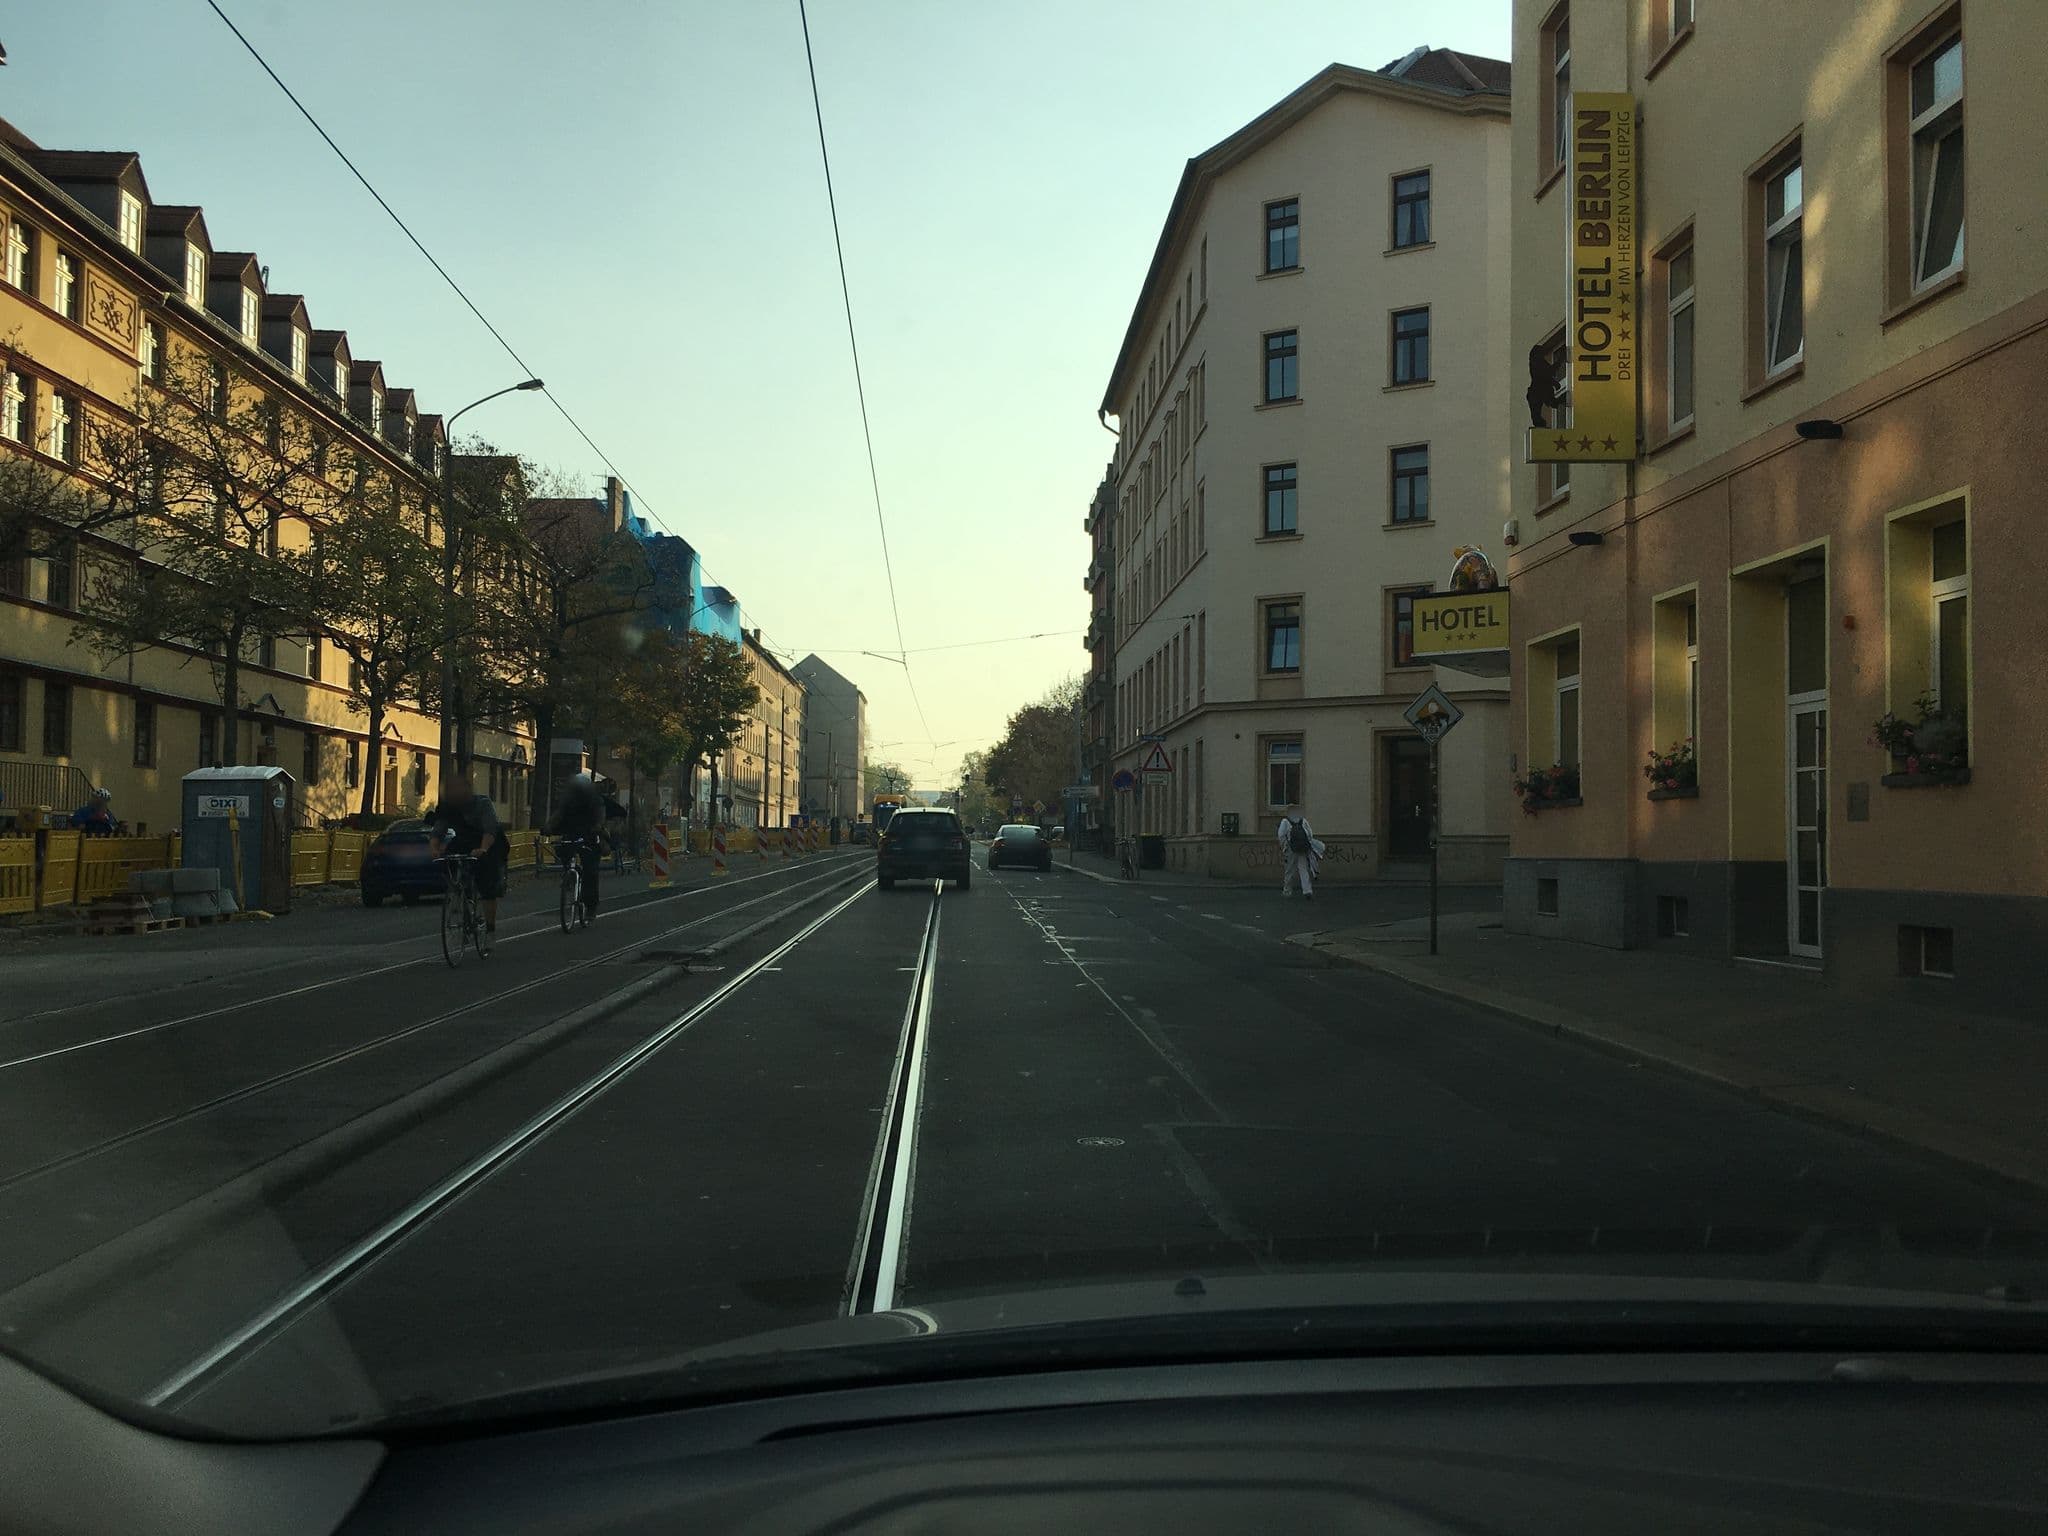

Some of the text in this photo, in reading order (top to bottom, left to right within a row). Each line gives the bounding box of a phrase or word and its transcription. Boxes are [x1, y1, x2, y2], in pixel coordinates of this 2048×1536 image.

[1578, 110, 1611, 381] HOTEL BERLIN
[1617, 110, 1631, 381] DREI IM HERZEN VON LEIPZIG
[1421, 605, 1500, 632] HOTEL
